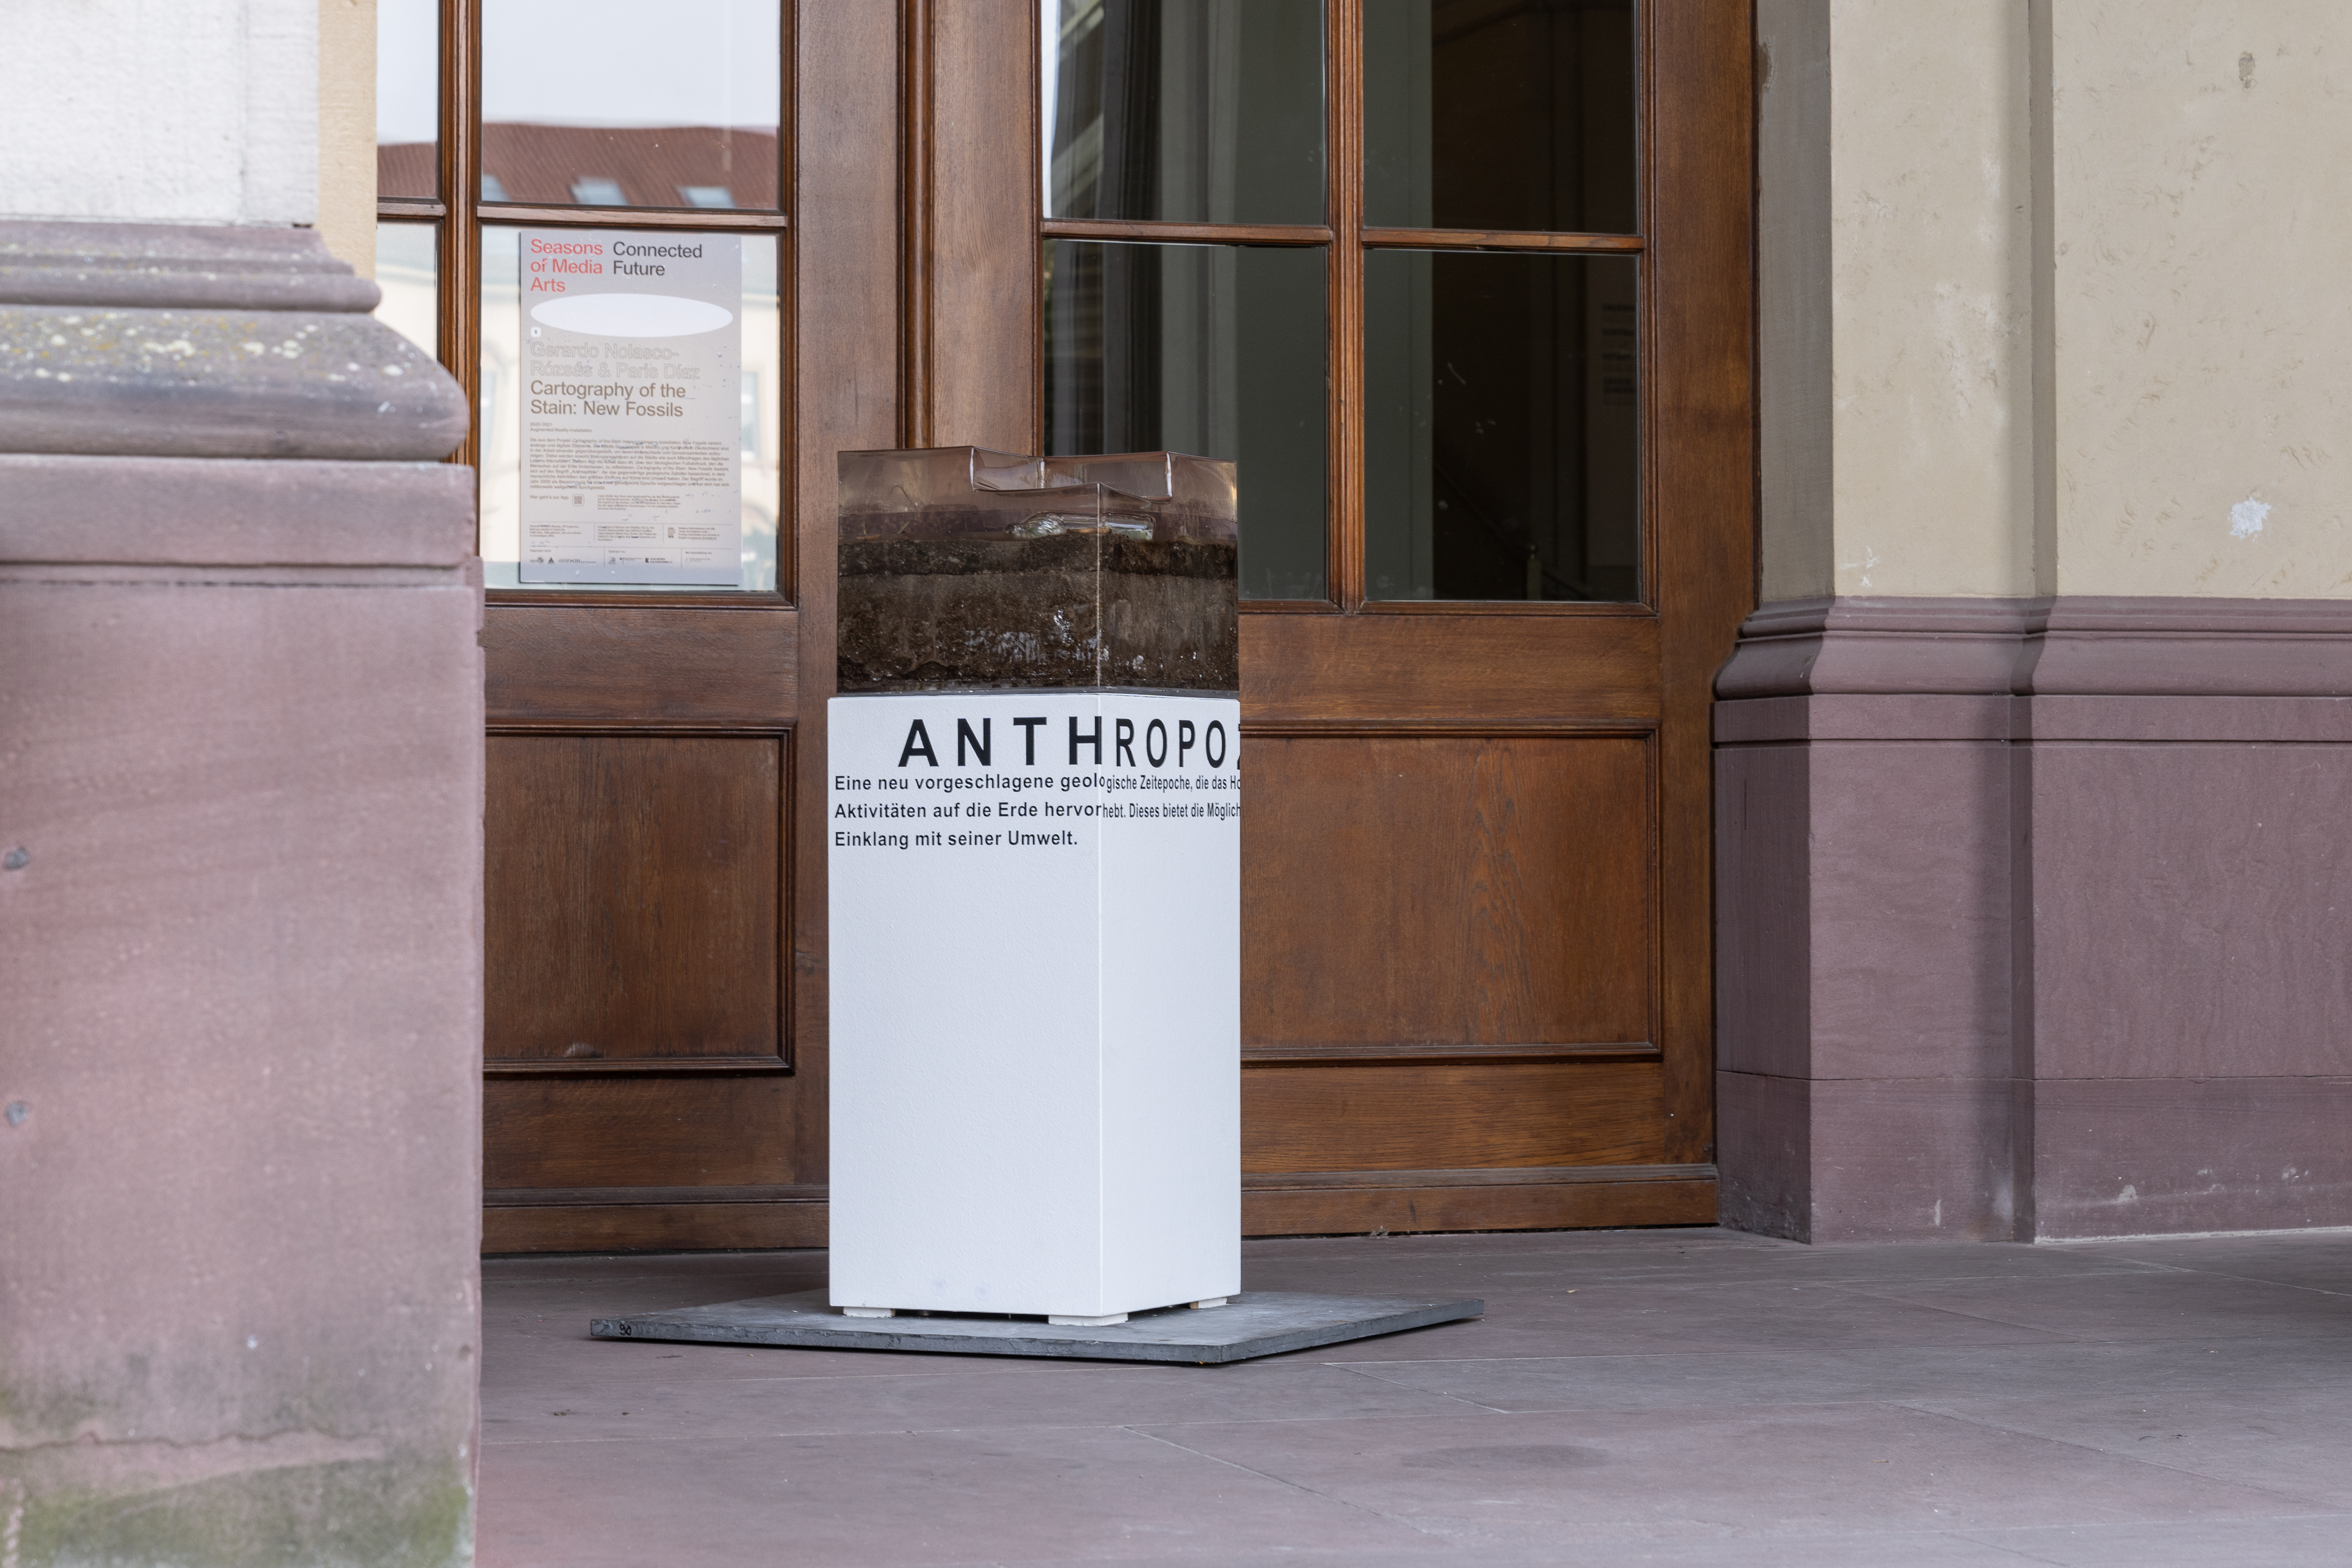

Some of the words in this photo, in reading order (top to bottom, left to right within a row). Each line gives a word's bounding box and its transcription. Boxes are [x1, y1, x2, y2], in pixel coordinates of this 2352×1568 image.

[531, 239, 603, 255] Seasons
[613, 241, 702, 258] Connected
[531, 258, 547, 272] of
[553, 259, 602, 274] Media
[614, 260, 665, 276] Future
[531, 277, 565, 292] Arts
[530, 342, 599, 358] Gerardo
[605, 343, 679, 359] Nolasco-
[530, 360, 592, 377] Rózsás
[598, 362, 610, 377] &
[617, 362, 658, 377] Paris
[664, 363, 700, 379] Díaz
[531, 380, 633, 401] Cartography
[640, 383, 656, 397] of
[661, 383, 686, 397] the
[531, 399, 576, 414] Stain:
[584, 401, 620, 415] New
[626, 401, 683, 417] Fossils
[898, 716, 1240, 769] ANTHROPO
[836, 776, 871, 790] Eine
[879, 779, 908, 789] neu
[915, 774, 1053, 793] vorgeschlagene
[1061, 773, 1137, 793] geologische
[1140, 775, 1192, 793] Zeitepoche,
[1196, 775, 1209, 789] die
[1212, 775, 1227, 789] das
[835, 803, 926, 818] Aktivitäten
[934, 802, 960, 817] auf
[967, 802, 991, 817] die
[999, 802, 1037, 817] Erde
[1045, 802, 1125, 818] hervorhebt.
[1130, 803, 1159, 817] Dieses
[1163, 803, 1188, 817] bietet
[1191, 803, 1204, 817] die
[836, 831, 908, 849] Einklang
[916, 831, 942, 846] mit
[948, 831, 1002, 845] seiner
[1009, 830, 1077, 845] Umwelt.
